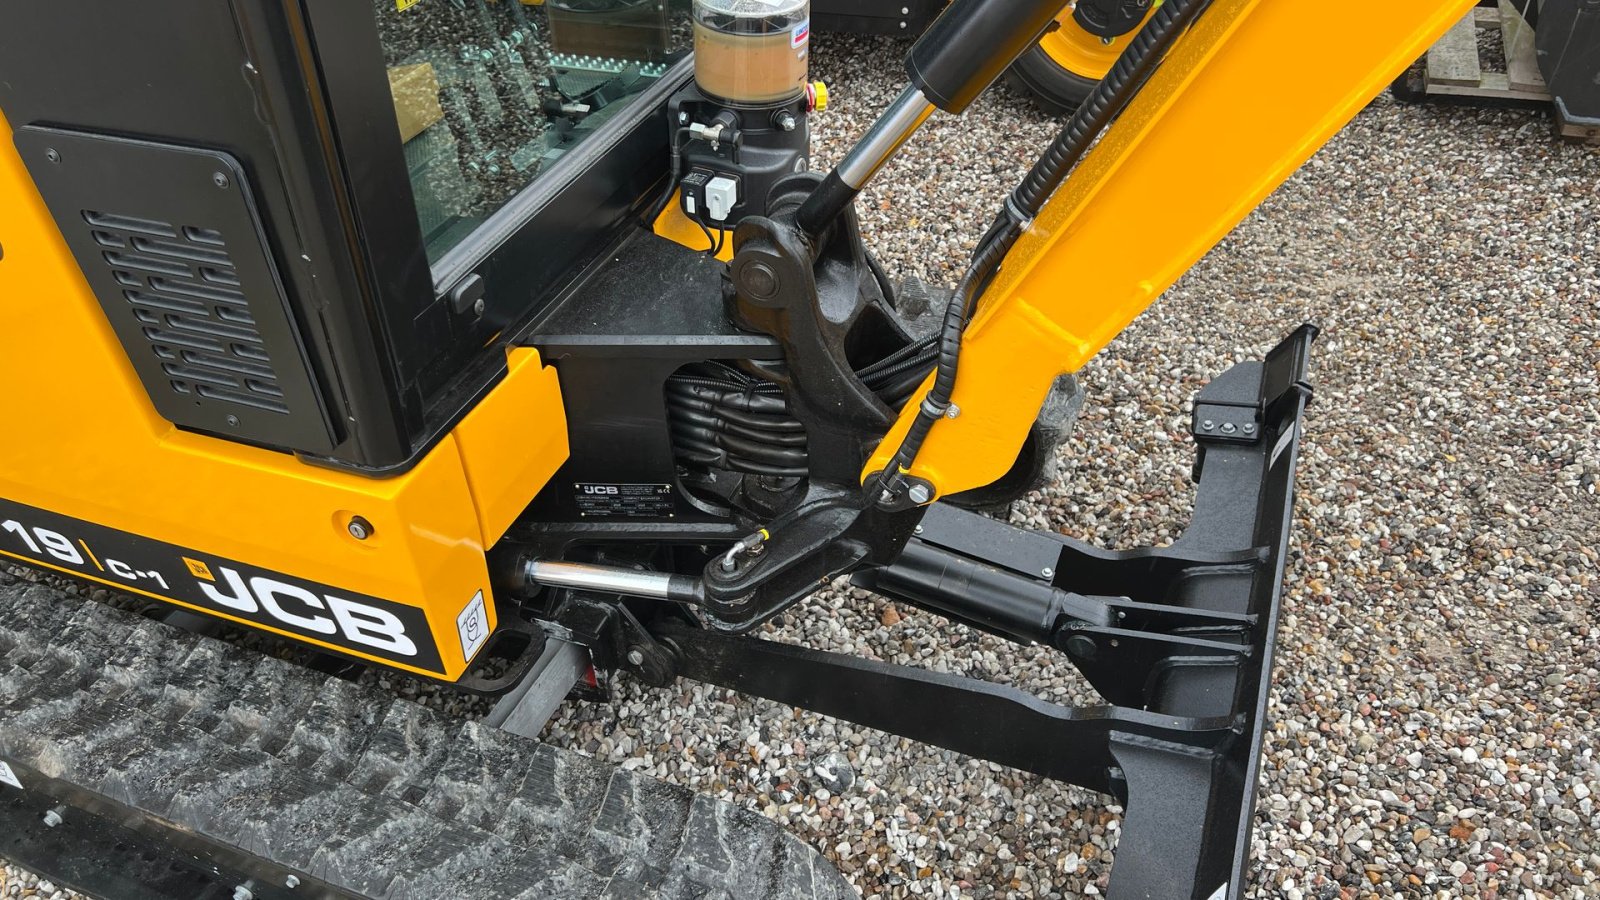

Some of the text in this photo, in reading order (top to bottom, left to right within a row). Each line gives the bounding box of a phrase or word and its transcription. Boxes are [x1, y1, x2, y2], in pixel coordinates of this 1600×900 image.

[584, 485, 618, 495] JCB
[1, 519, 85, 565] 19
[197, 566, 418, 657] JCB
